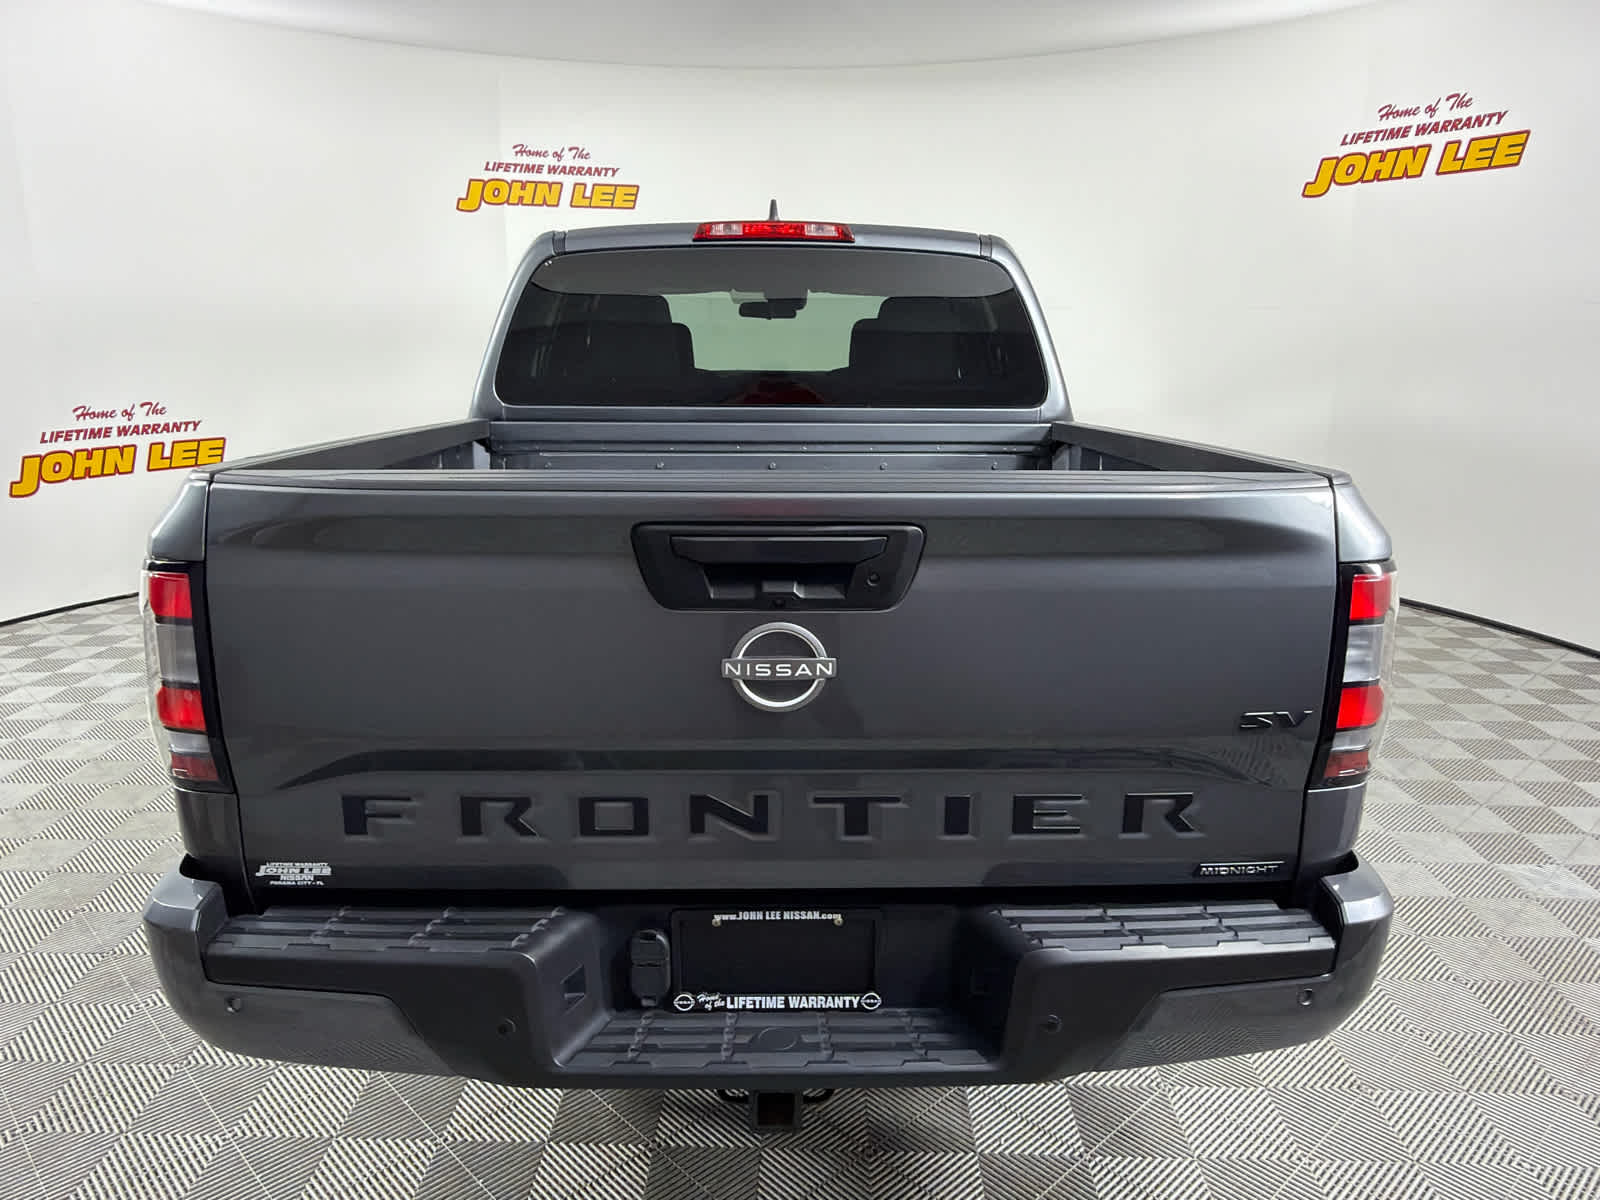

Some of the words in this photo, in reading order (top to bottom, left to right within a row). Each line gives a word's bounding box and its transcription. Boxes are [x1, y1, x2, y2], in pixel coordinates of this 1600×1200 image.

[1377, 104, 1420, 121] Home
[1424, 98, 1441, 119] of
[1445, 92, 1473, 111] The
[1340, 125, 1413, 146] LIFETIME
[1414, 110, 1508, 136] WARRANTY
[512, 143, 549, 159] Home
[552, 147, 564, 162] of
[568, 147, 591, 160] The
[484, 161, 545, 174] LIFETIME
[547, 164, 619, 177] WARRANTY
[1302, 144, 1432, 198] JOHN
[1435, 129, 1531, 175] LEE
[456, 178, 563, 212] JOHN
[570, 182, 640, 209] LEE
[72, 405, 117, 421] Home
[121, 404, 135, 421] of
[140, 401, 167, 417] The
[40, 426, 113, 444] LIFETIME
[116, 420, 201, 437] WARRANTY
[9, 444, 137, 498] JOHN
[146, 437, 226, 472] LEE
[724, 661, 834, 678] NISSAN
[1240, 711, 1313, 728] SV
[341, 791, 1204, 840] FRONTIER
[256, 865, 300, 876] JOHN
[303, 865, 332, 876] LEE
[1200, 865, 1279, 875] MIDNIGHT
[765, 911, 781, 920] LEE
[726, 996, 792, 1009] LIFETIME
[793, 996, 860, 1009] WARRANTY
